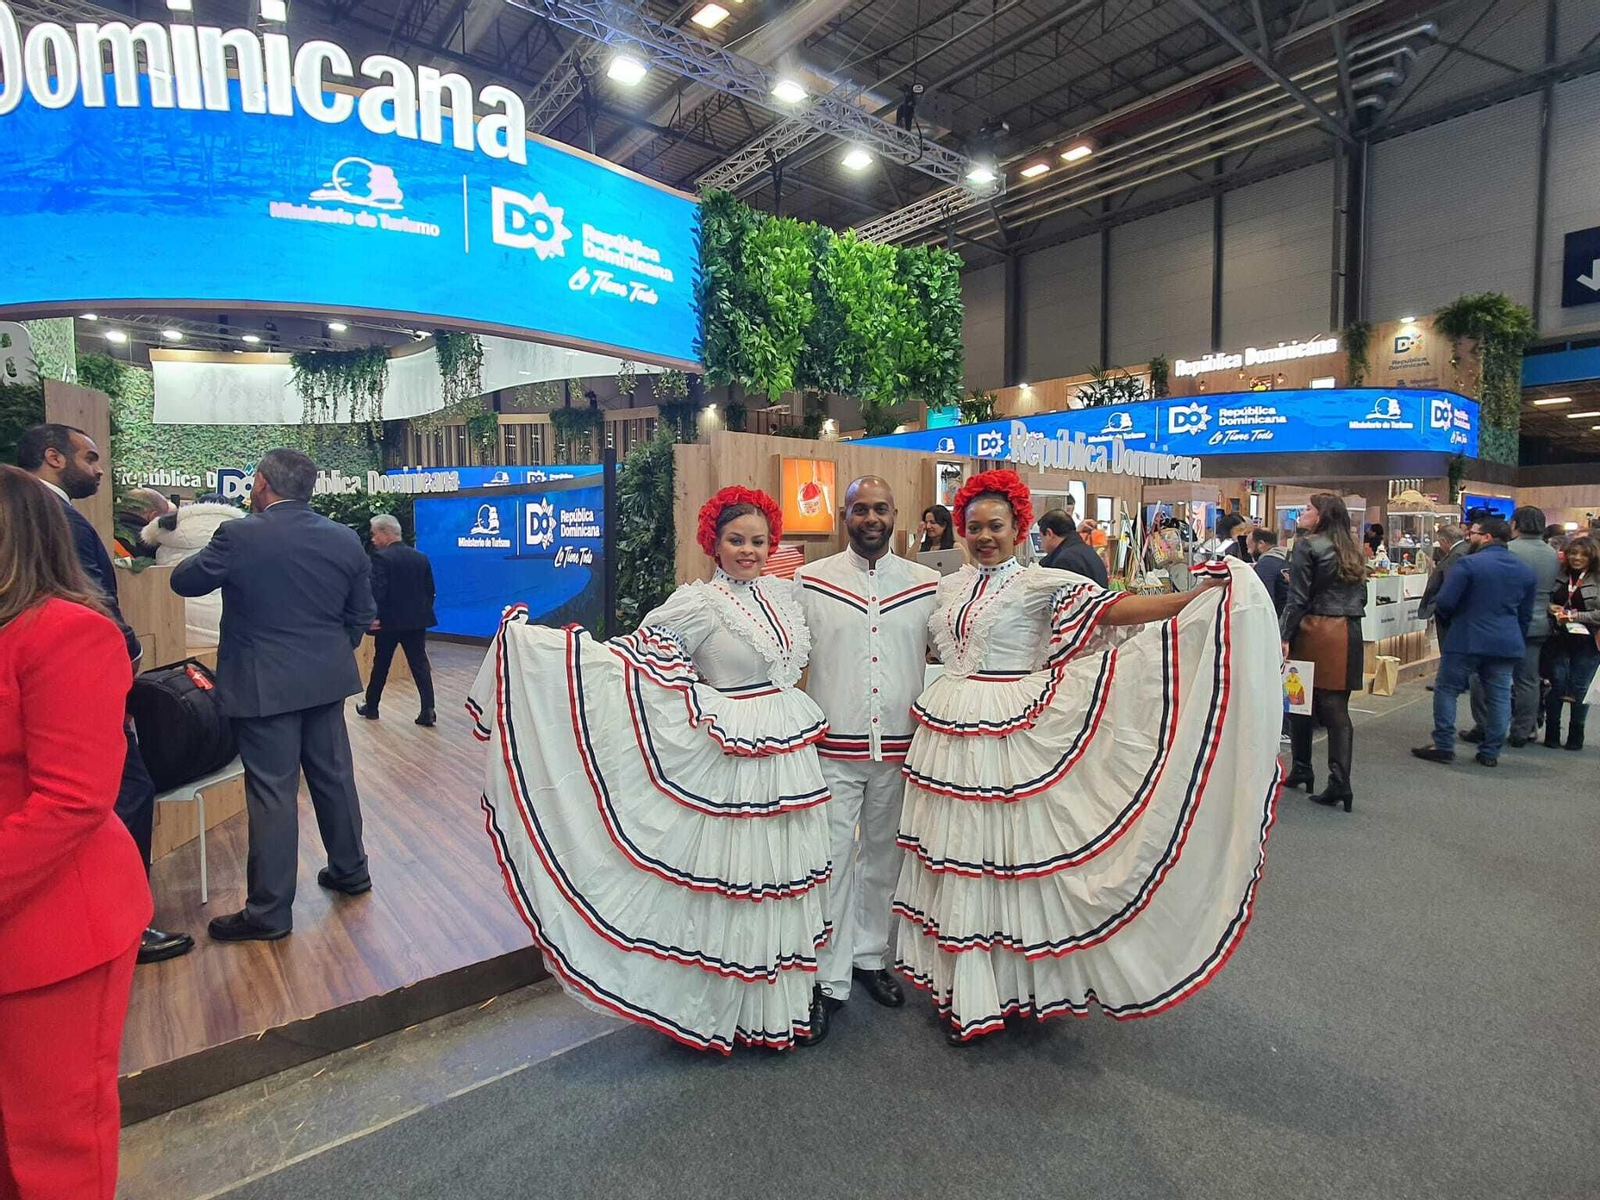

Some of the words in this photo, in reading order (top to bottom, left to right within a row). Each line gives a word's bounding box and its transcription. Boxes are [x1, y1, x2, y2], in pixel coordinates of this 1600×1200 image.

[1175, 352, 1243, 377] República
[1245, 337, 1338, 367] Dominicana
[1168, 401, 1212, 436] DO
[1218, 406, 1277, 418] República
[1218, 415, 1288, 427] Dominicana
[1208, 430, 1224, 445] Lo
[1222, 429, 1250, 445] Tiene
[1250, 429, 1274, 442] Todo
[1010, 420, 1107, 474] República
[1112, 437, 1202, 482] Dominicana
[367, 466, 459, 496] Dominicana
[560, 508, 594, 524] República
[560, 524, 600, 538] Dominicana
[579, 547, 593, 566] Todo
